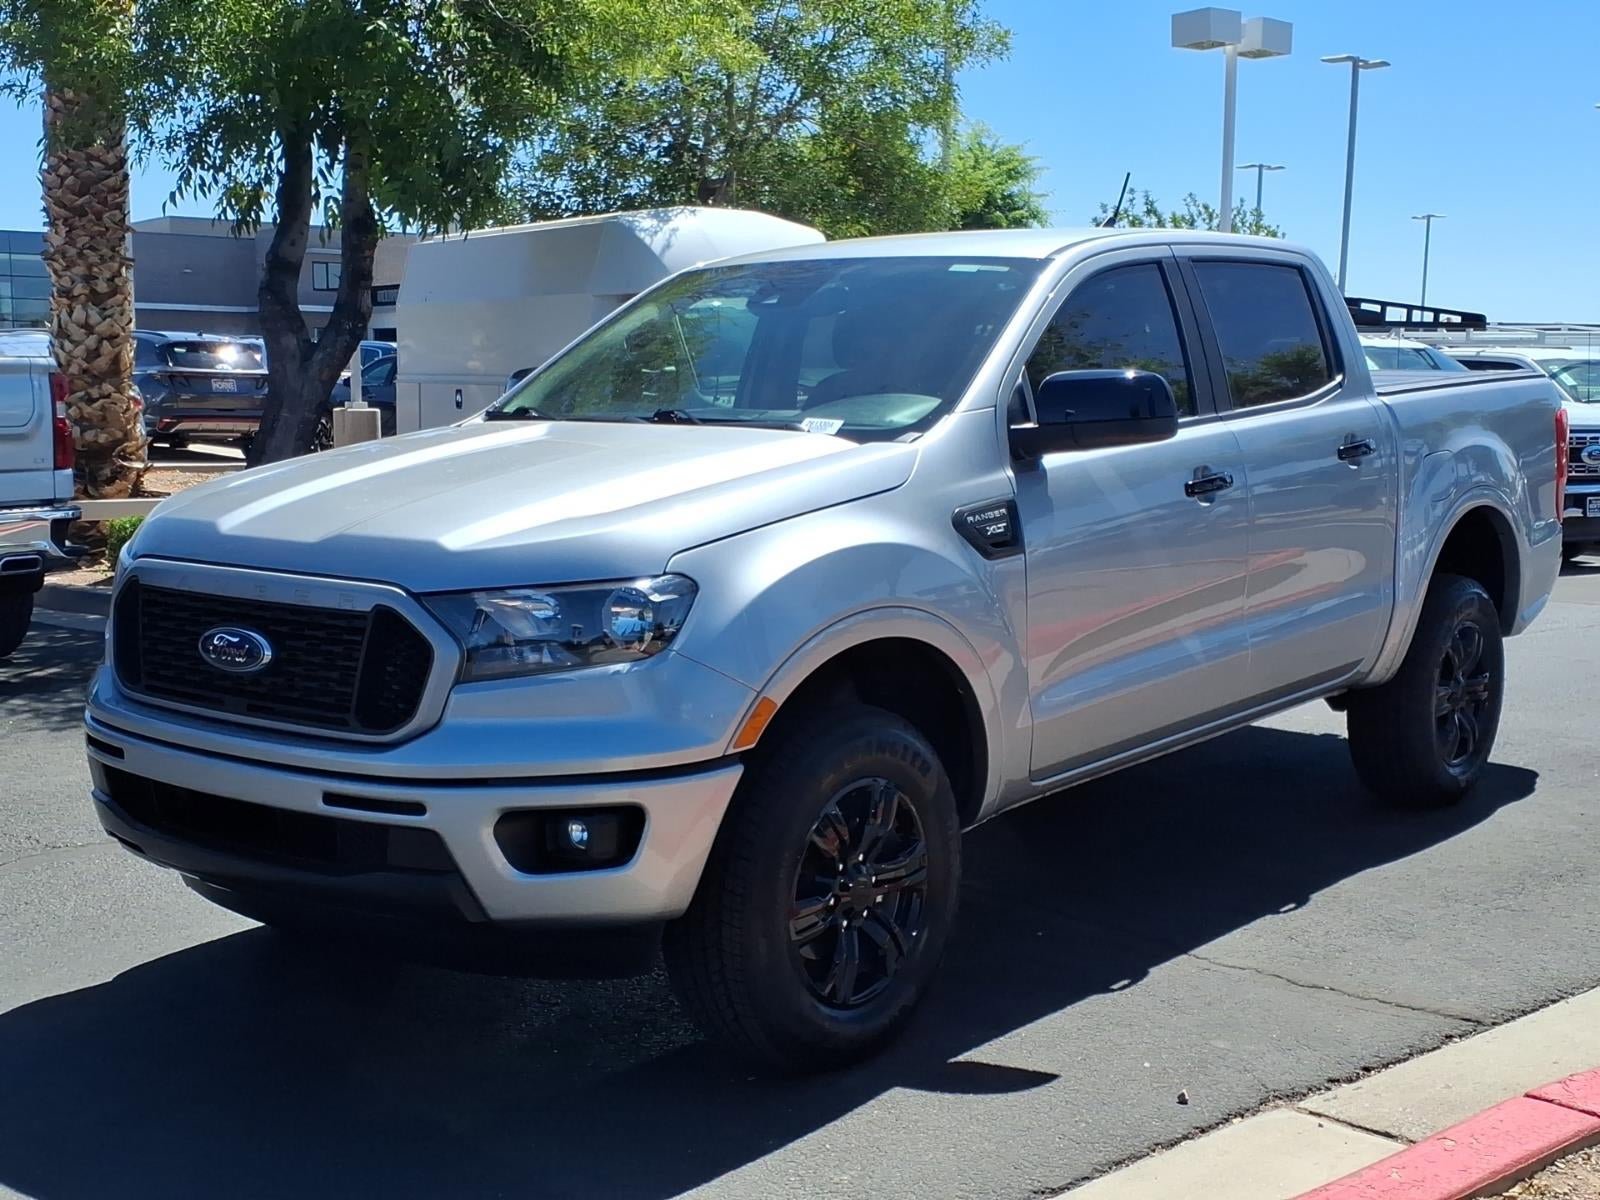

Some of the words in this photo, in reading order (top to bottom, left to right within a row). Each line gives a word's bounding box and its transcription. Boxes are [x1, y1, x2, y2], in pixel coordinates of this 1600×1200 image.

[966, 508, 1007, 524] RANGER
[986, 523, 1007, 536] XLT
[208, 633, 249, 663] Ford
